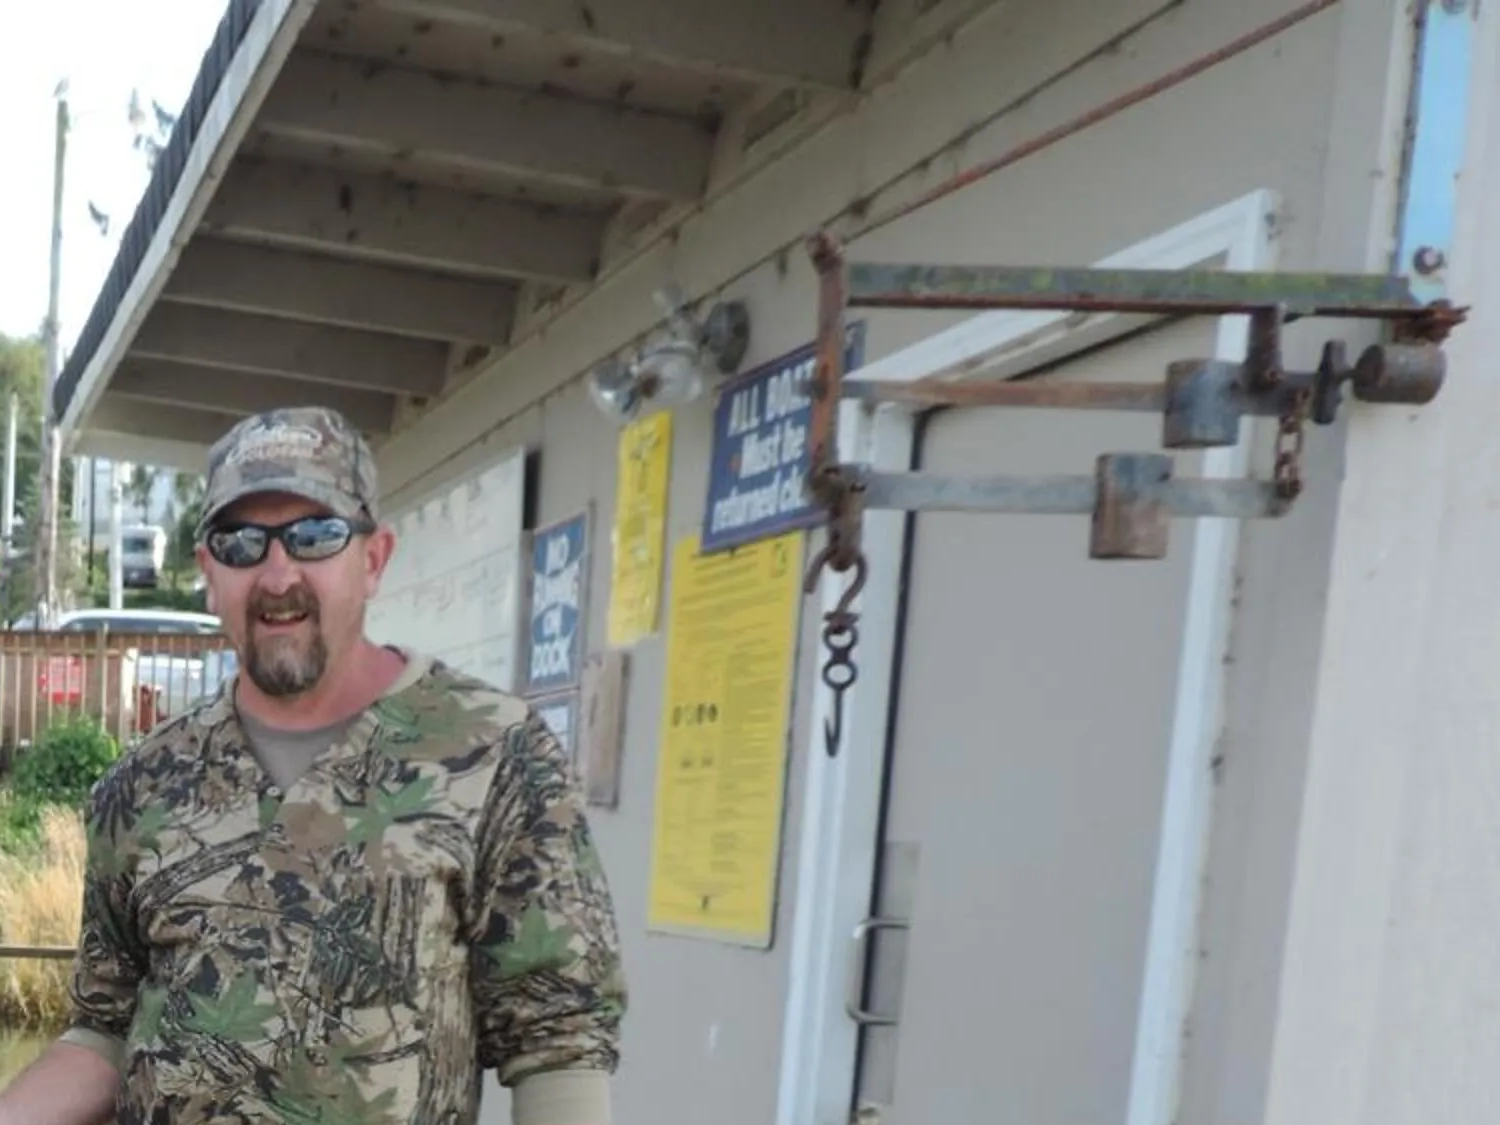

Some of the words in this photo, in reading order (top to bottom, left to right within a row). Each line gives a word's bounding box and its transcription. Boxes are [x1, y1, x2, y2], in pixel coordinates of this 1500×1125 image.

[727, 385, 760, 438] ALL
[739, 423, 781, 480] Must
[781, 416, 806, 464] be
[710, 469, 782, 535] returned
[546, 534, 569, 576] NO
[532, 637, 571, 679] DOCK
